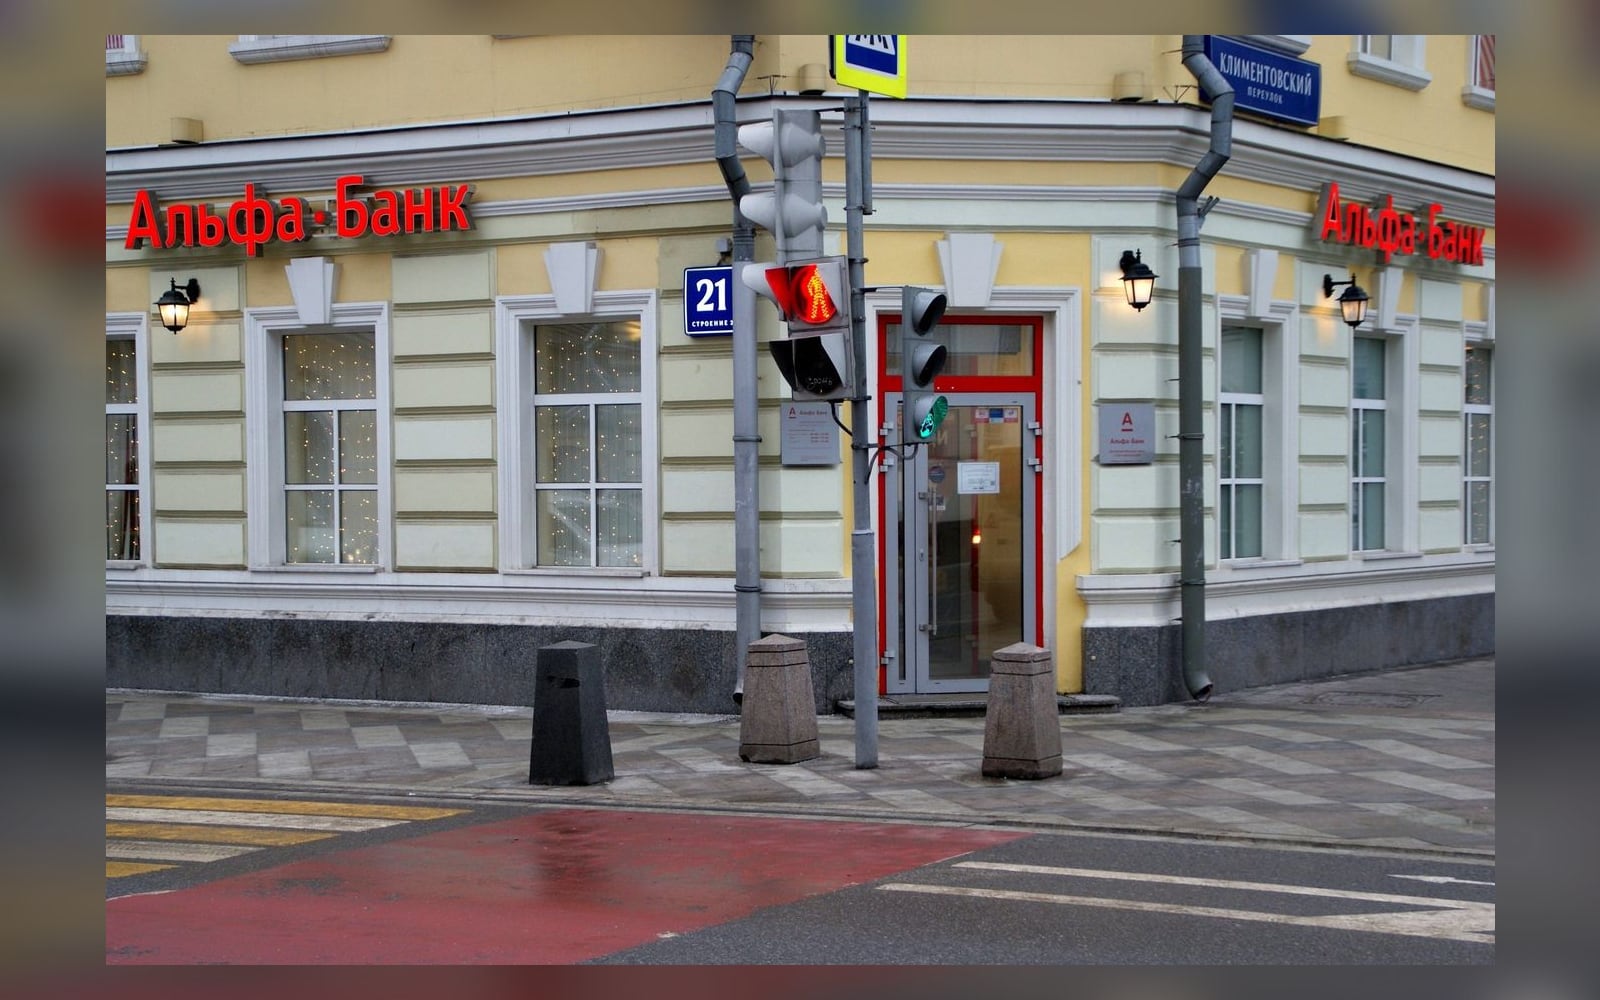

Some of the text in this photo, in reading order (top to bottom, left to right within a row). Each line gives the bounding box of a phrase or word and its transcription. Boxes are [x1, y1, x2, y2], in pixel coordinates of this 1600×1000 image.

[1220, 52, 1312, 96] КЛИМЕНТОВСКИЙ
[1247, 86, 1283, 104] ПЕРЕУЛОК
[696, 278, 727, 312] 21
[691, 319, 728, 328] СТРОЕНИЕ
